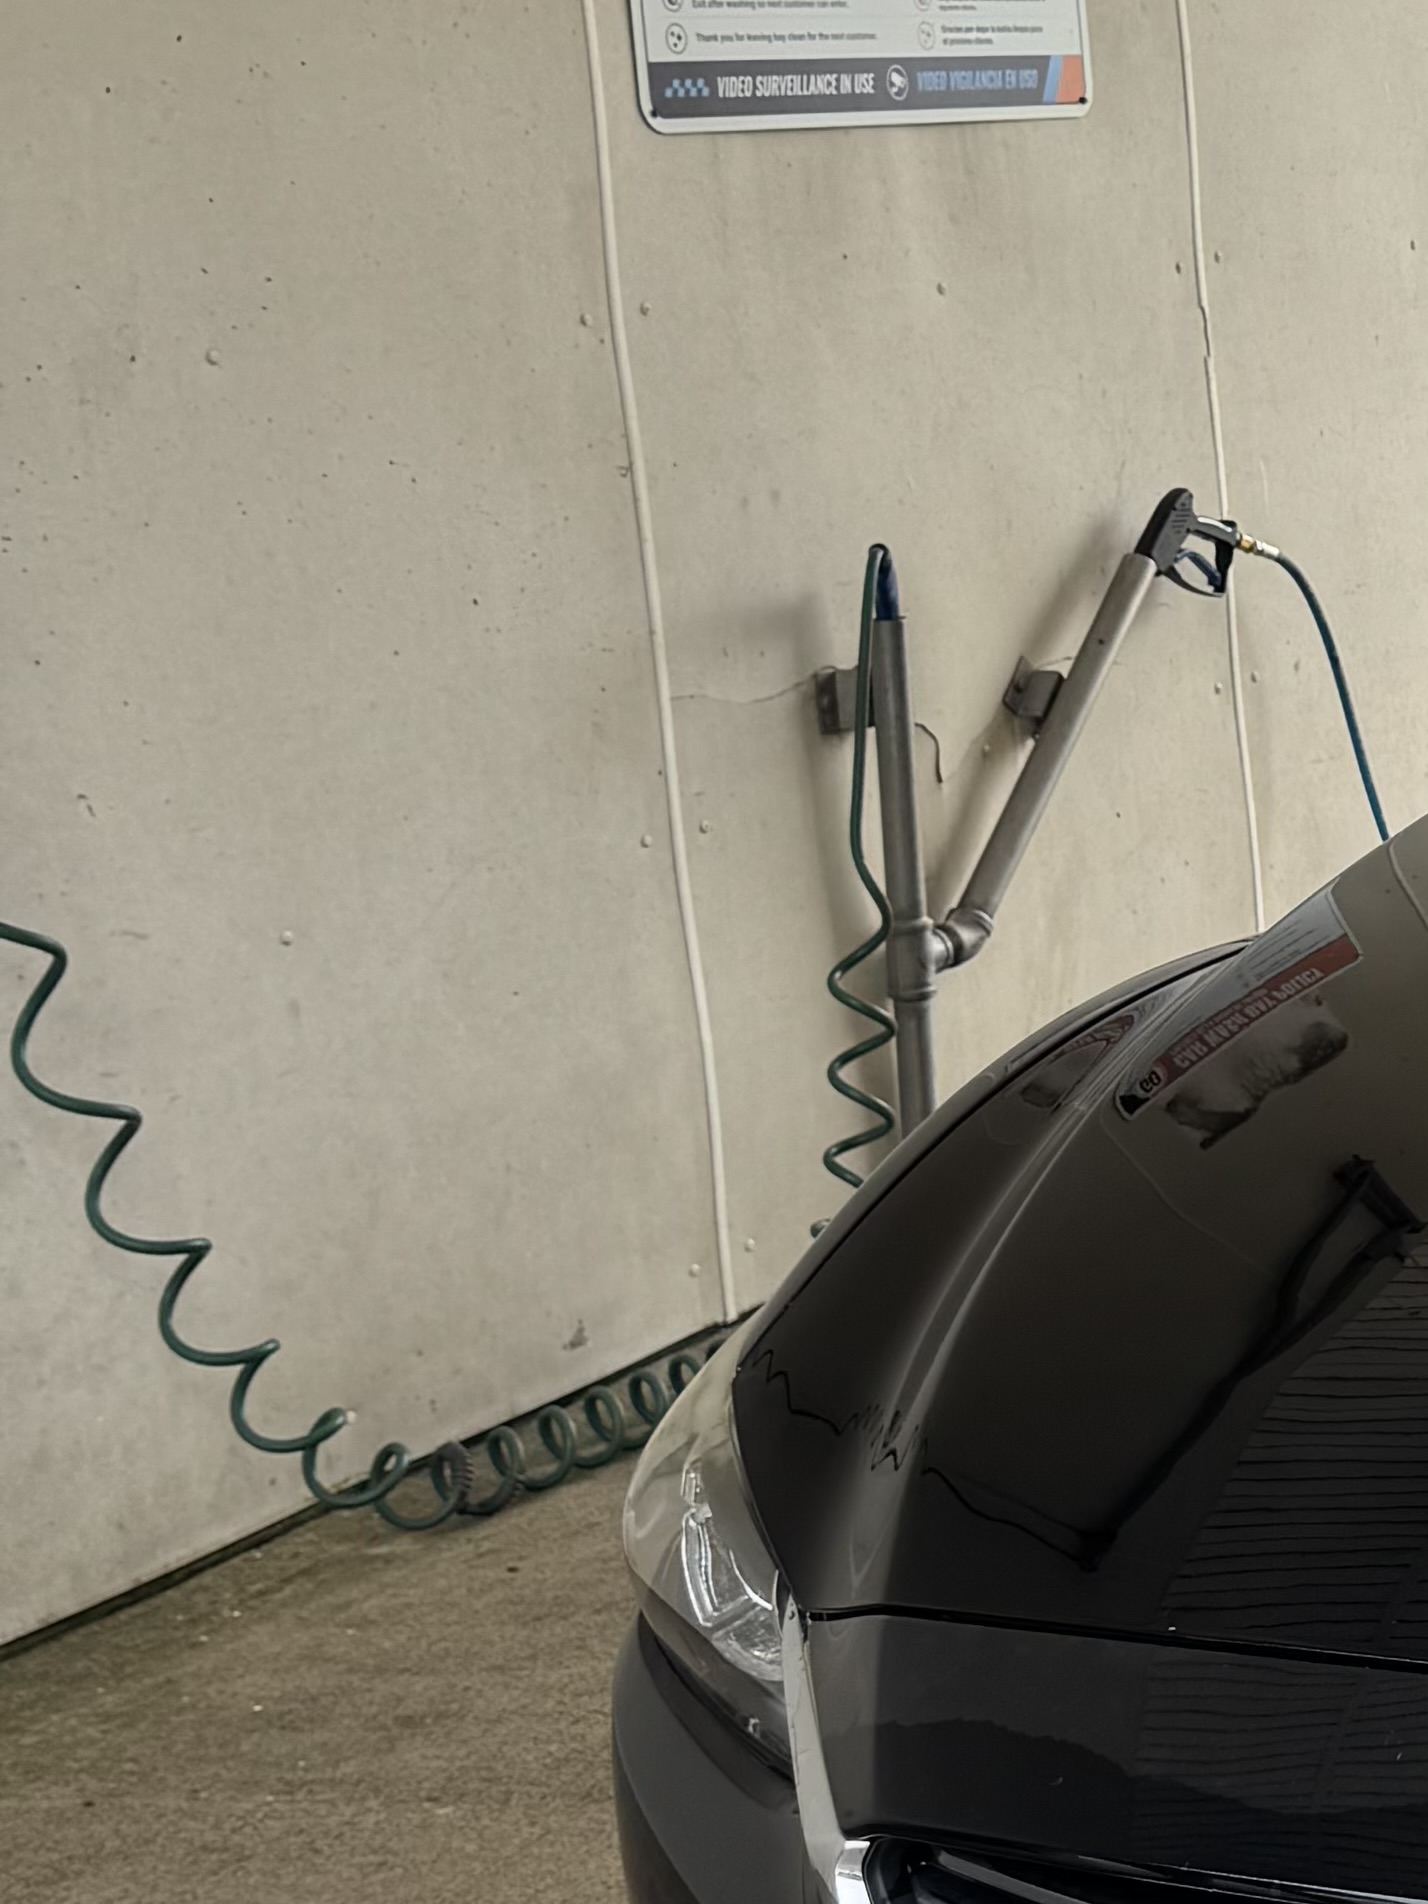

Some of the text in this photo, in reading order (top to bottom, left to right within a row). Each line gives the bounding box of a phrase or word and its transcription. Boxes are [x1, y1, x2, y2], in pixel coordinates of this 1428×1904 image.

[717, 72, 875, 97] VIDEO SURVEILLANCE IN USE
